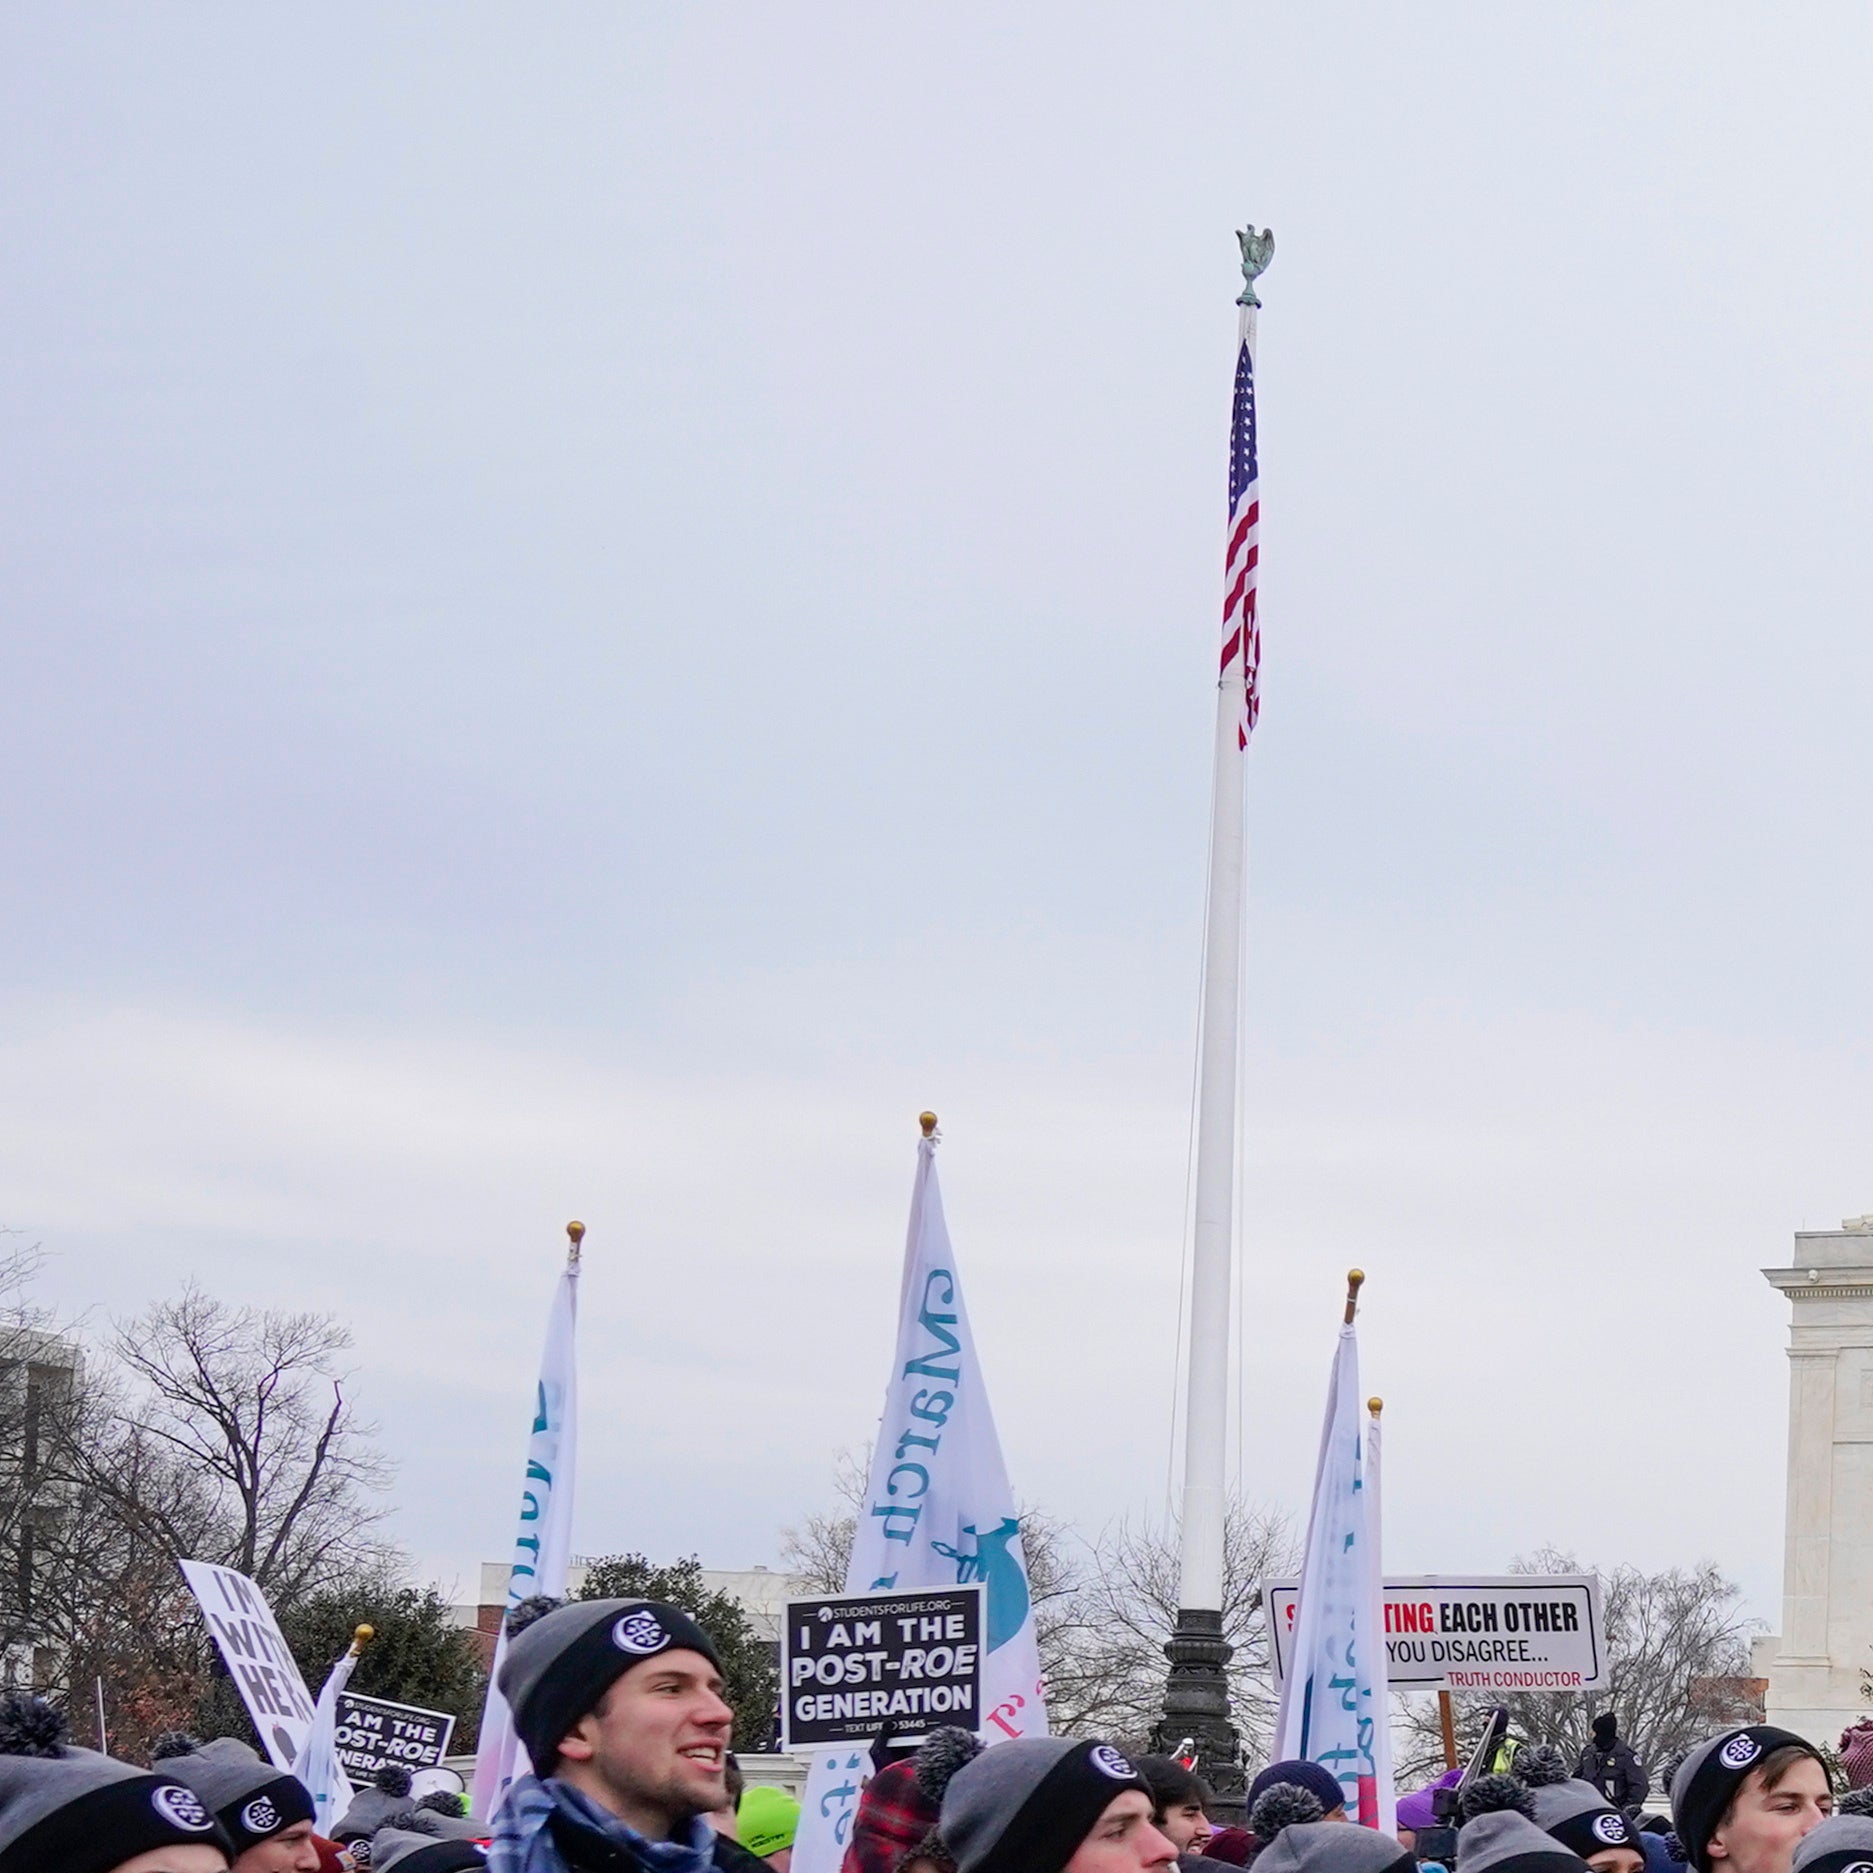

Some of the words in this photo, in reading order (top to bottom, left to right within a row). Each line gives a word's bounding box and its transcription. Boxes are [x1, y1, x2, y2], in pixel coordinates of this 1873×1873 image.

[834, 1599, 951, 1619] STUDENTSFORLIFE.ORG
[1440, 1602, 1499, 1633] EACH
[1504, 1602, 1579, 1632] OTHER
[800, 1626, 810, 1650] I
[826, 1621, 882, 1648] AM
[897, 1614, 965, 1643] THE
[791, 1644, 978, 1688] POST-ROE
[1385, 1641, 1427, 1663] YOU
[1433, 1640, 1548, 1663] DISAGREE...
[1447, 1671, 1491, 1688] TRUTH
[1494, 1671, 1582, 1687] CONDUCTOR
[795, 1684, 973, 1722] GENERATION
[344, 1710, 384, 1731] AM
[391, 1720, 438, 1743] THE
[866, 1722, 884, 1732] LIF
[334, 1725, 441, 1764] OST-ROE
